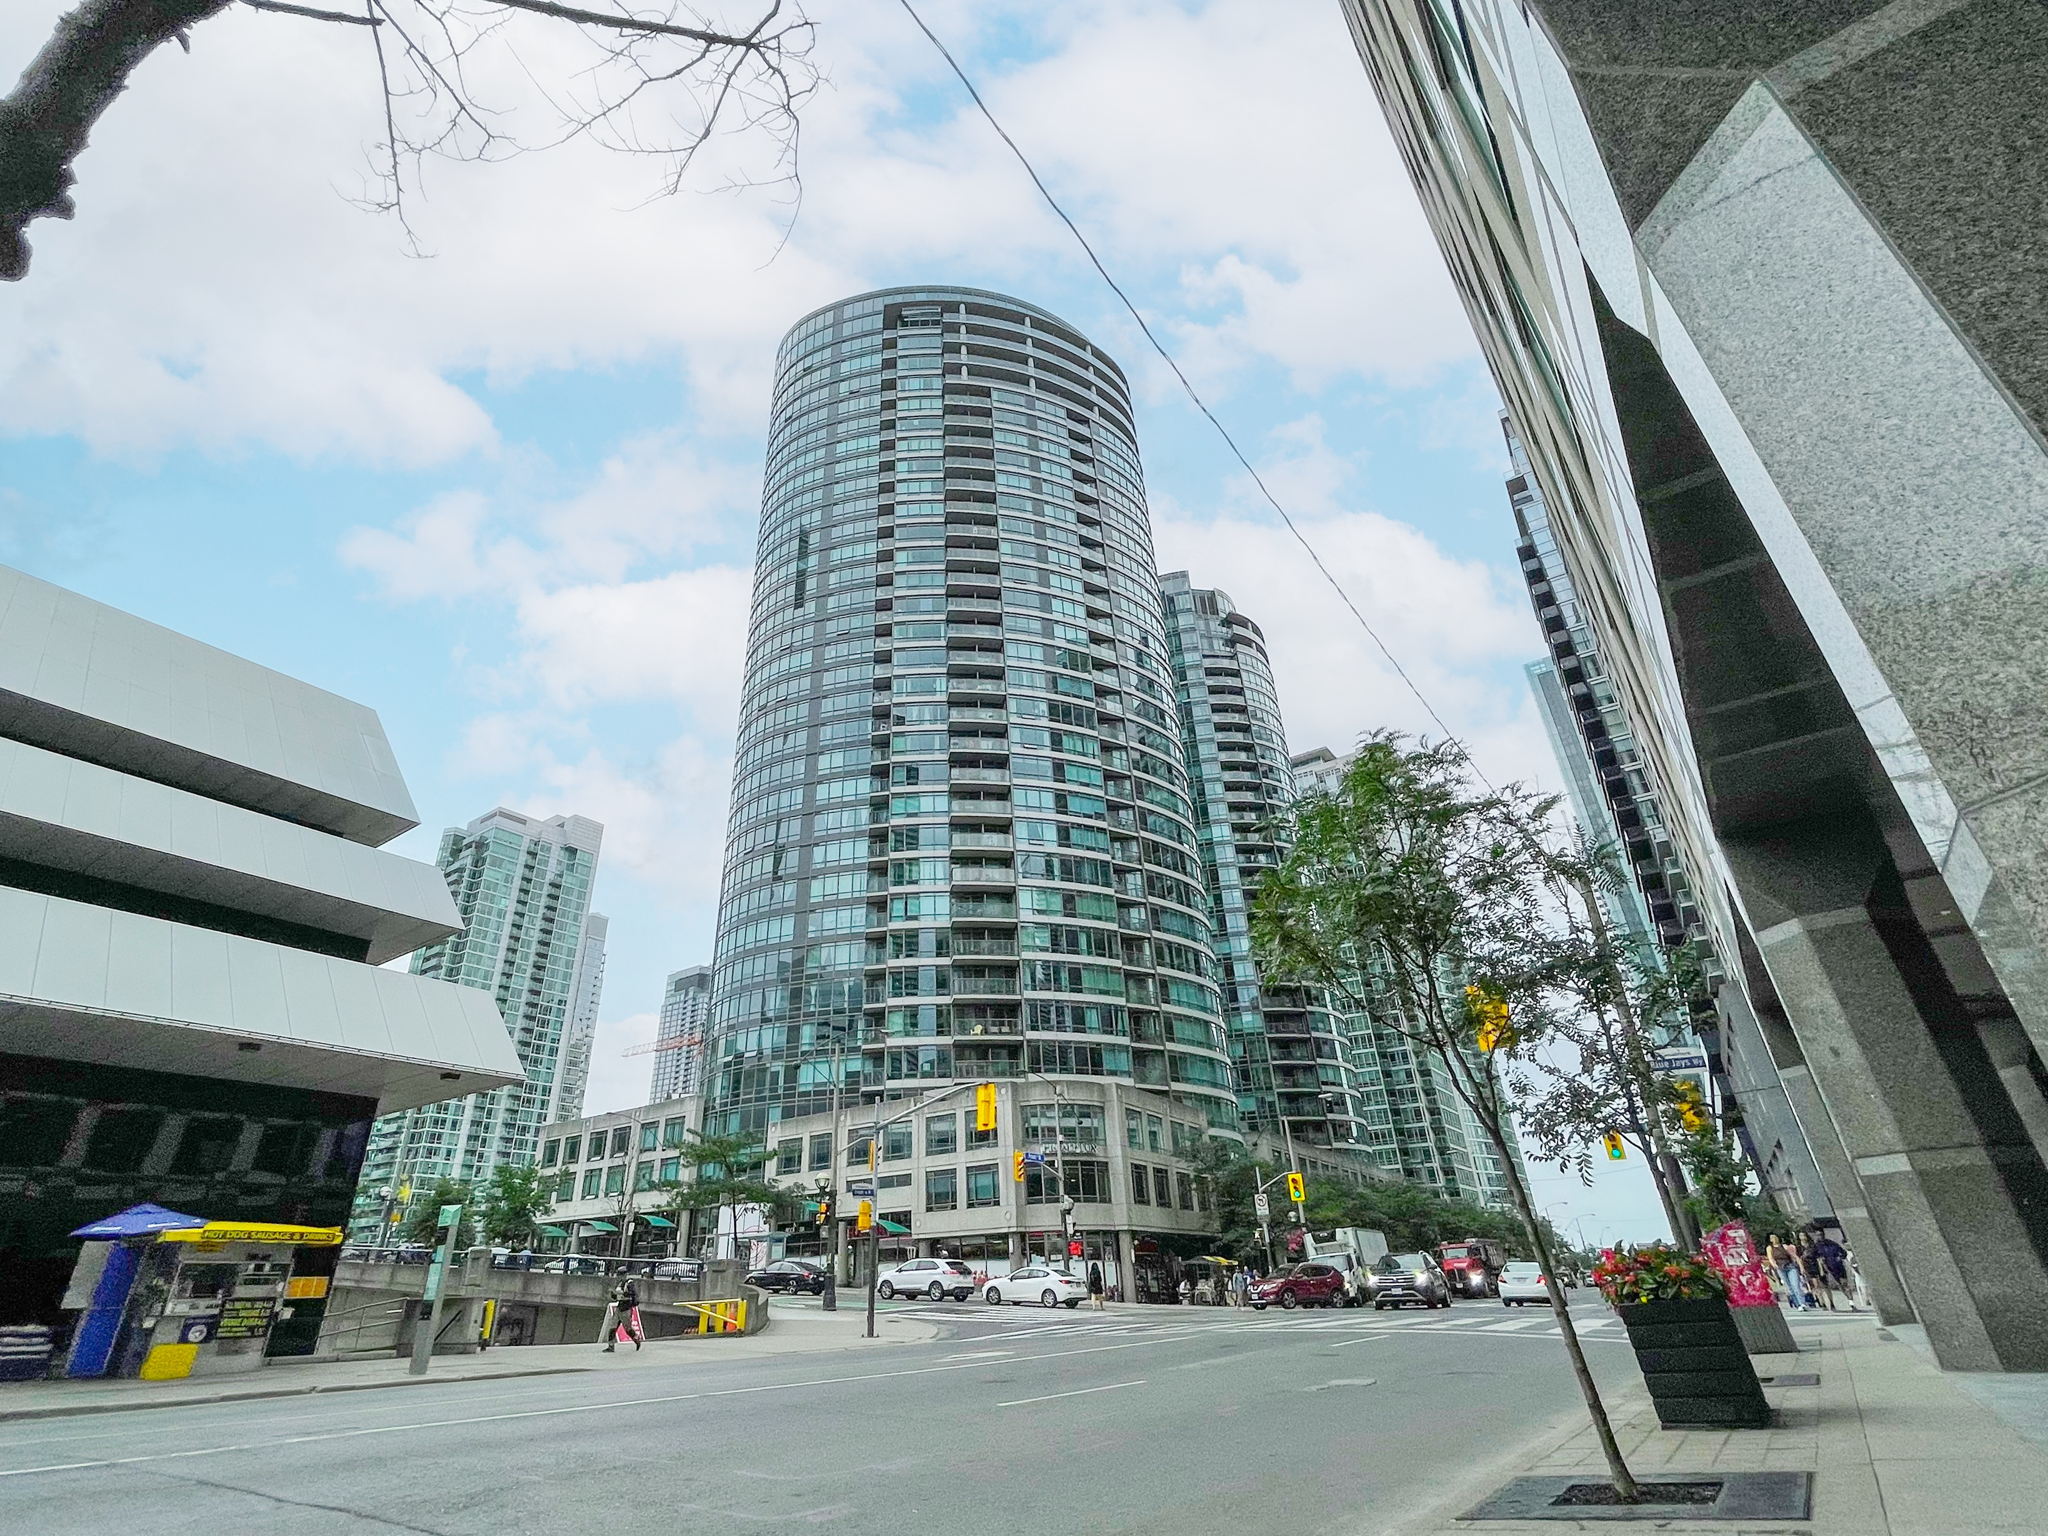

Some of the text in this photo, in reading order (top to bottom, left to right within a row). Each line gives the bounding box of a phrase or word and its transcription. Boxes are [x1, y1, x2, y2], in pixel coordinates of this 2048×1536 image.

[1672, 1059, 1691, 1067] Jays
[1692, 1058, 1703, 1066] Wy
[204, 1231, 224, 1239] HOT
[227, 1231, 248, 1239] DOG
[250, 1231, 291, 1240] SAUSAGE
[293, 1232, 300, 1240] &
